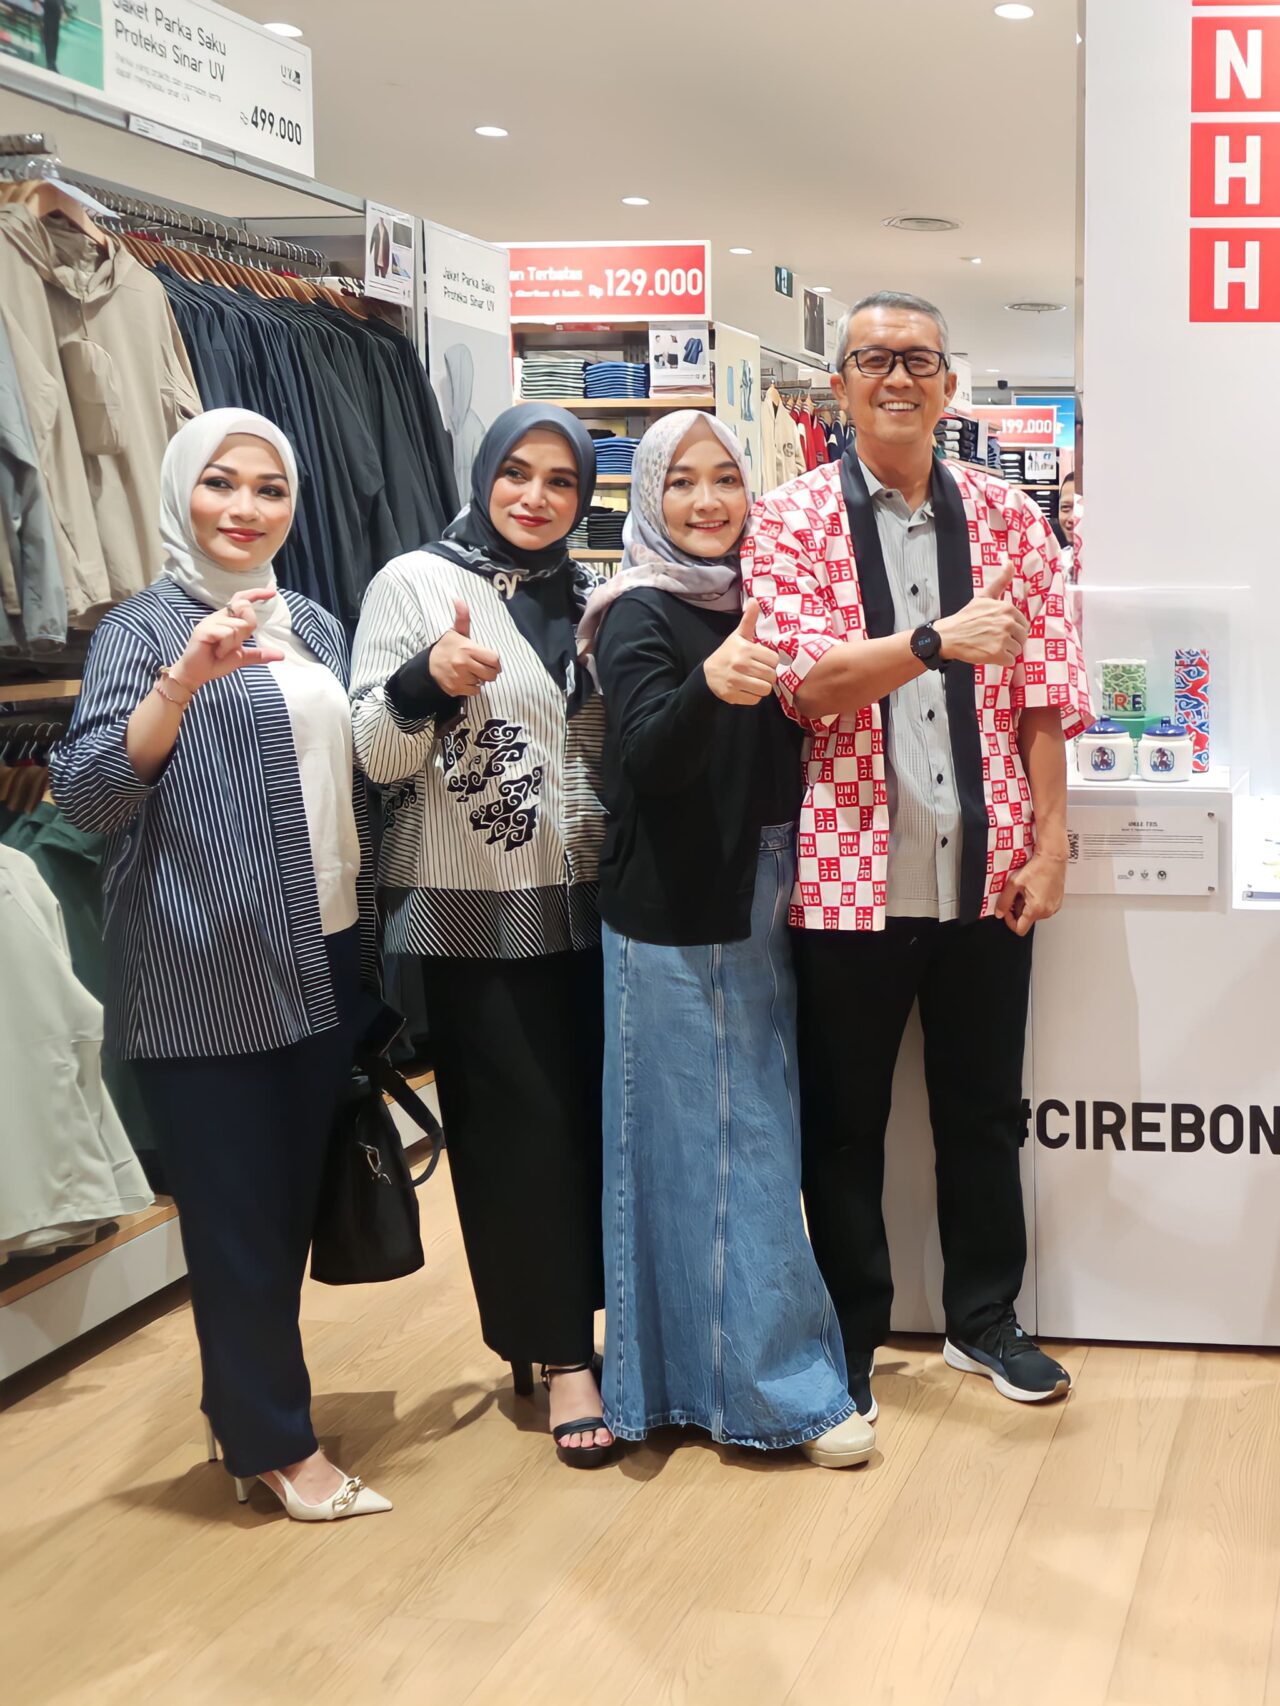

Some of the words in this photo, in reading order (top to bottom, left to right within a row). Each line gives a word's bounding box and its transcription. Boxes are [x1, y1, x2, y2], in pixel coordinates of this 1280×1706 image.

[154, 7, 192, 41] Parka
[197, 27, 226, 56] Saku
[114, 18, 168, 58] Proteksi
[172, 44, 204, 73] Sinar
[209, 59, 225, 82] UV
[837, 785, 855, 794] UNI
[838, 796, 857, 805] QLO
